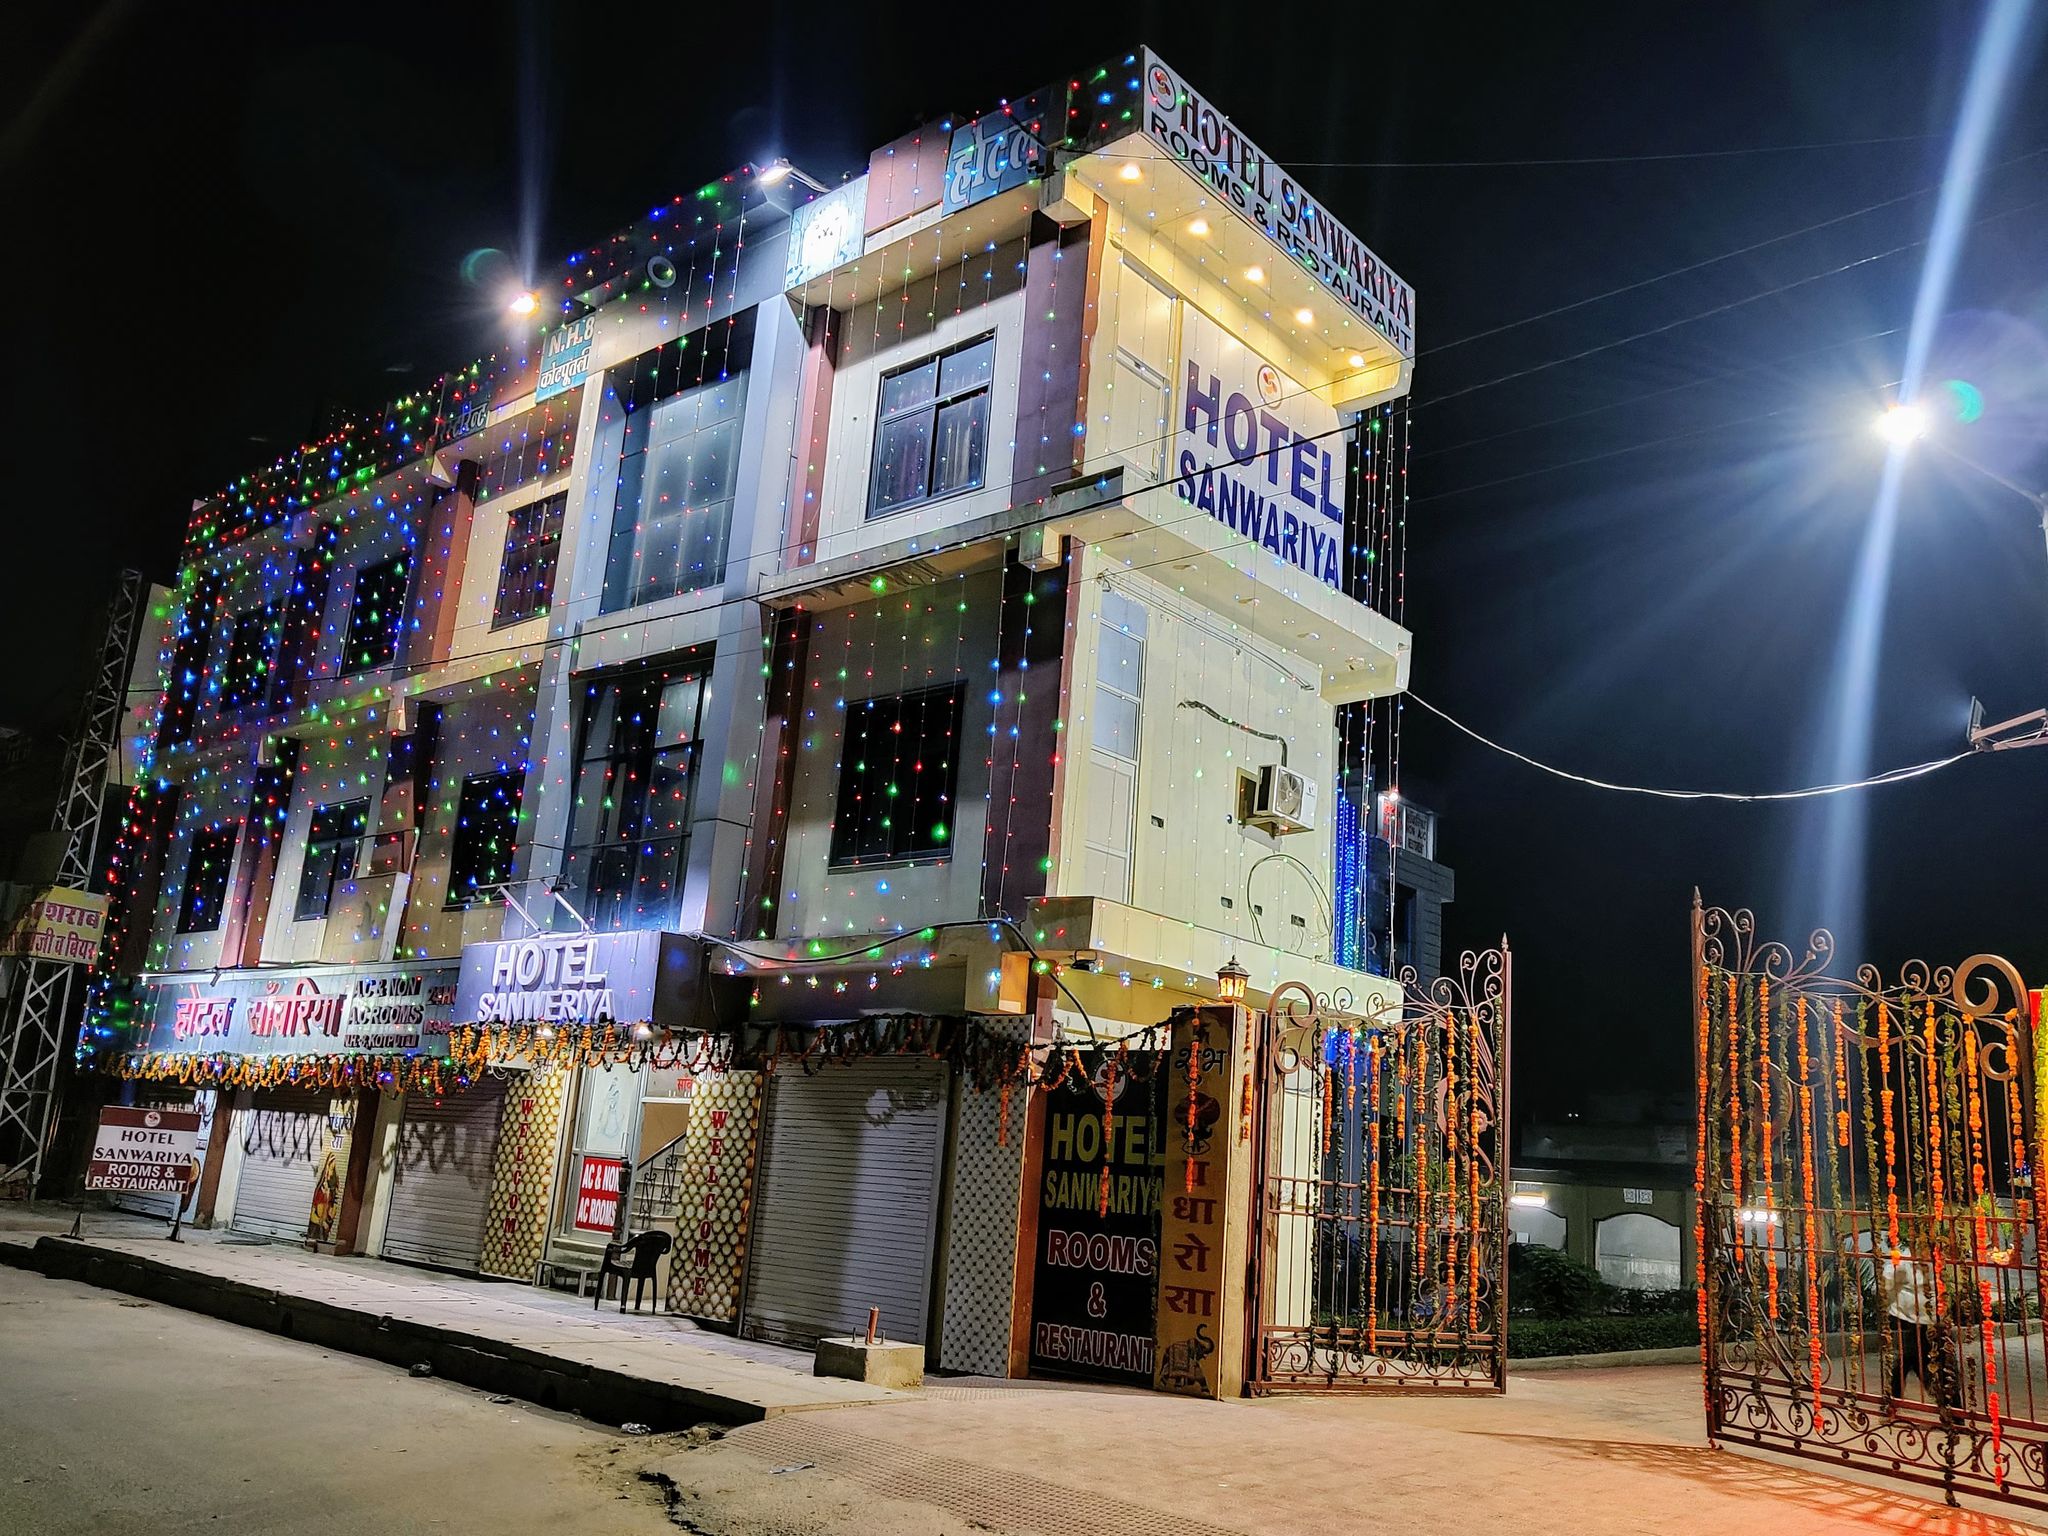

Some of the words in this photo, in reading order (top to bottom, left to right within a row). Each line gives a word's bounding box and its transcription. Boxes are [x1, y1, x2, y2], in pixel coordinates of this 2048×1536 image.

[1178, 83, 1275, 205] HOTEL
[1281, 177, 1412, 331] SANWARIYA
[1151, 110, 1247, 209] ROOMS
[1253, 202, 1271, 231] &
[1276, 218, 1412, 352] RESTAURANT
[1185, 360, 1343, 525] HOTEL
[1178, 449, 1340, 595] SANWARIYA
[45, 902, 101, 929] शराब
[492, 938, 607, 990] HOTEL
[389, 977, 422, 997] NON
[477, 988, 615, 1023] SANWERIYA
[176, 983, 236, 1042] होटल
[370, 1005, 425, 1025] ROOMS
[94, 1147, 192, 1164] SANWARIYA
[121, 1130, 175, 1145] HOTEL
[1050, 1112, 1166, 1167] HOTEL
[91, 1175, 187, 1192] RESTAURANT
[107, 1163, 161, 1178] ROOMS
[164, 1166, 175, 1179] &
[582, 1163, 595, 1190] AC
[594, 1164, 603, 1190] &
[577, 1197, 590, 1223] AC
[589, 1198, 617, 1227] ROOMS
[694, 1110, 729, 1297] WELCOME
[1047, 1229, 1156, 1277] ROOMS
[1087, 1281, 1107, 1319] &
[1036, 1322, 1154, 1375] RESTAURANT
